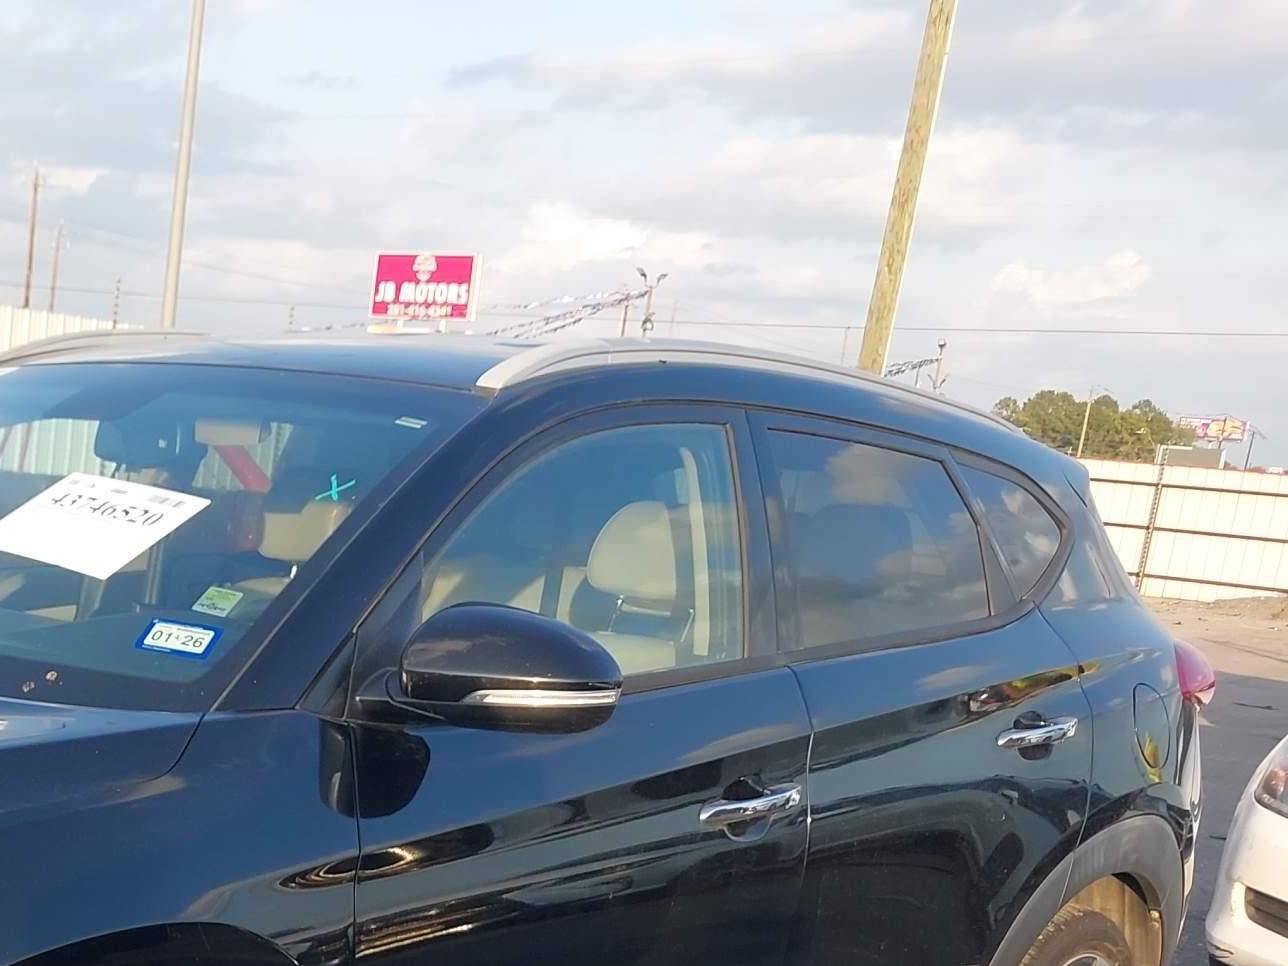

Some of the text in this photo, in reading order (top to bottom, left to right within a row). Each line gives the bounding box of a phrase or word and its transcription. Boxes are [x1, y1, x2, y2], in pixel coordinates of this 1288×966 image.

[398, 281, 469, 305] MOTORS
[51, 492, 164, 527] 43746520
[151, 629, 173, 643] 01
[181, 634, 206, 649] 26
